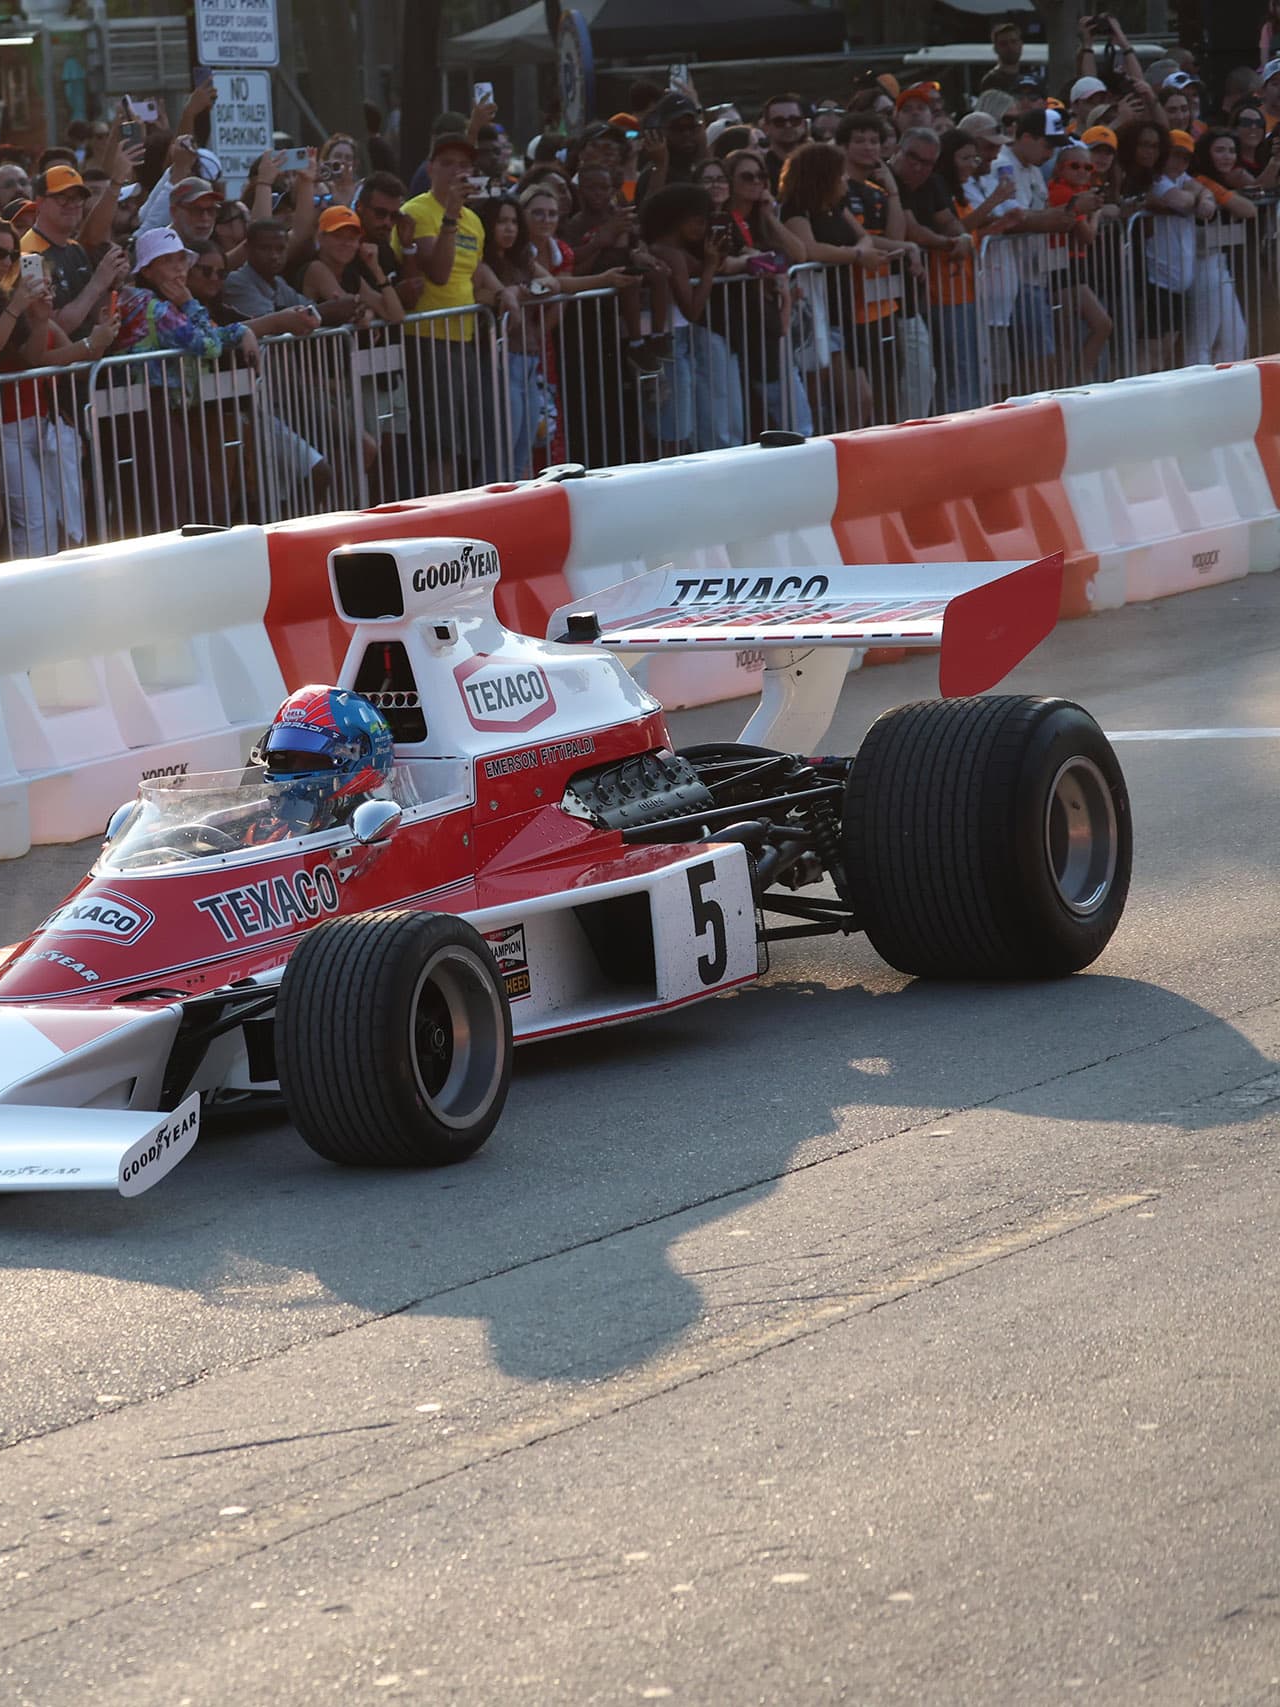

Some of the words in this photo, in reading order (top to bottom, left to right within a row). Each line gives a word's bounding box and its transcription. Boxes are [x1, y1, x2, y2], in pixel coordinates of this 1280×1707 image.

[205, 15, 234, 27] EXCEPT
[236, 15, 268, 28] DURING
[203, 30, 219, 42] CITY
[221, 30, 273, 43] COMMISSION
[218, 46, 258, 58] MEETINGS
[230, 77, 249, 101] NO
[216, 104, 235, 122] BOAT
[236, 104, 266, 122] TRAILER
[219, 127, 267, 145] PARKING
[412, 548, 499, 593] GOODYEAR
[671, 575, 829, 606] TEXACO
[736, 651, 764, 668] YODOC
[466, 671, 545, 714] TEXACO
[484, 751, 538, 779] EMERSON
[540, 736, 596, 765] FITTIPALDI
[194, 864, 340, 943] TEXACO
[50, 903, 136, 933] XACO
[686, 860, 728, 986] 5
[492, 940, 521, 957] AMPION
[505, 974, 530, 994] HEED
[123, 1111, 197, 1183] GOODYEAR
